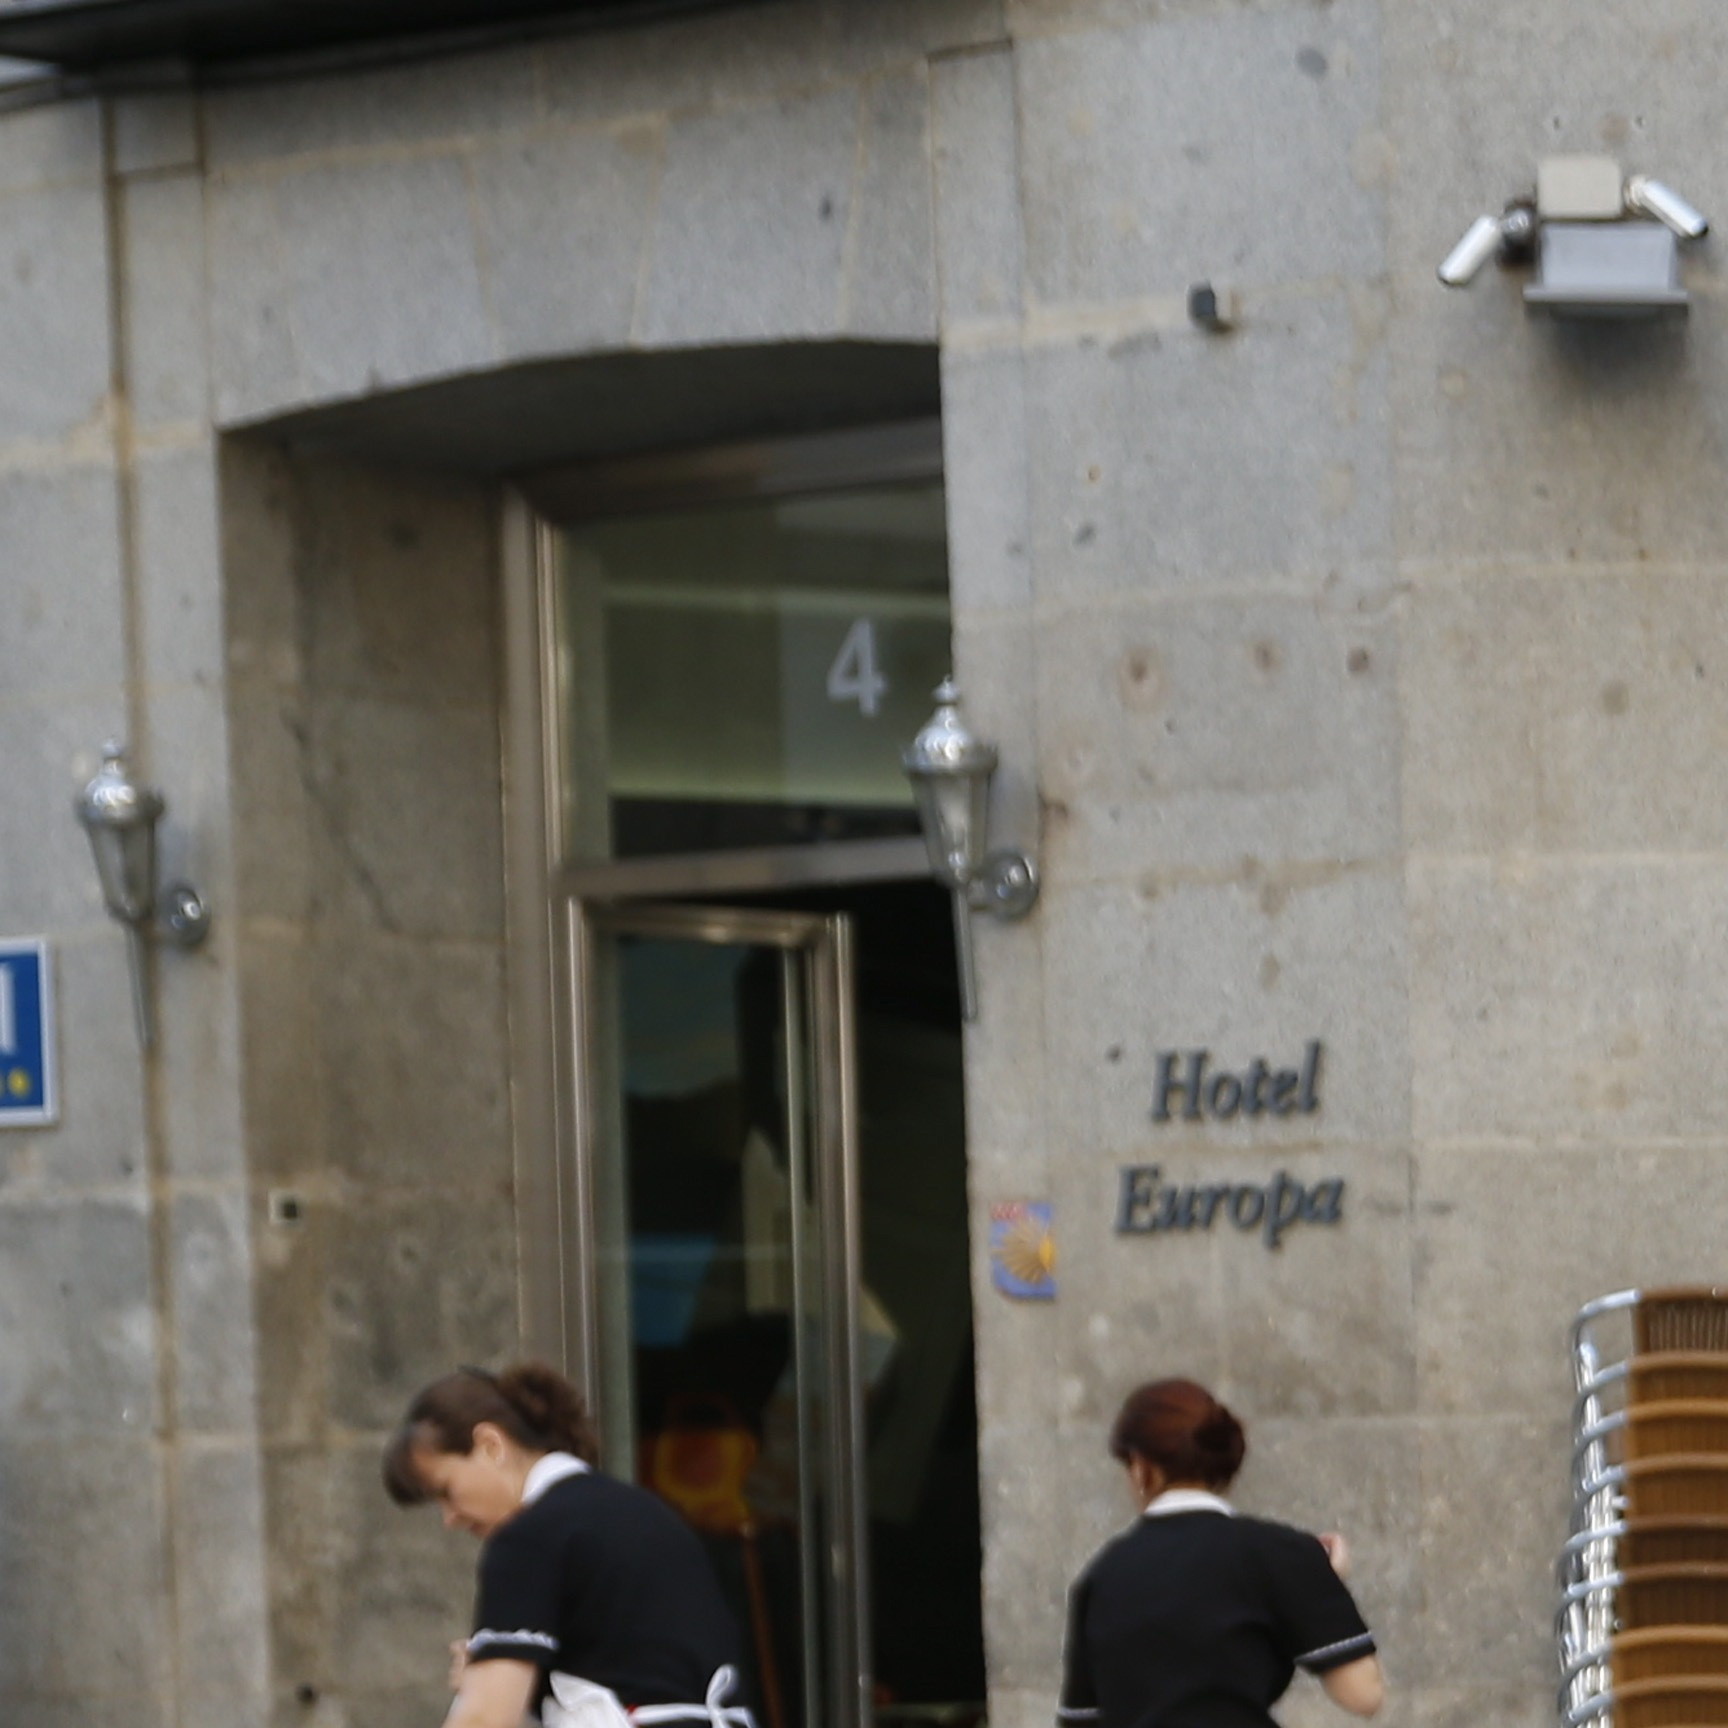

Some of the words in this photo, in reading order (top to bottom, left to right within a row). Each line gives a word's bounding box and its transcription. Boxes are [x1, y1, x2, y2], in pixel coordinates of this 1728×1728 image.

[826, 618, 888, 718] 4
[1150, 1039, 1323, 1123] Hotel
[1115, 1164, 1345, 1251] Europa
